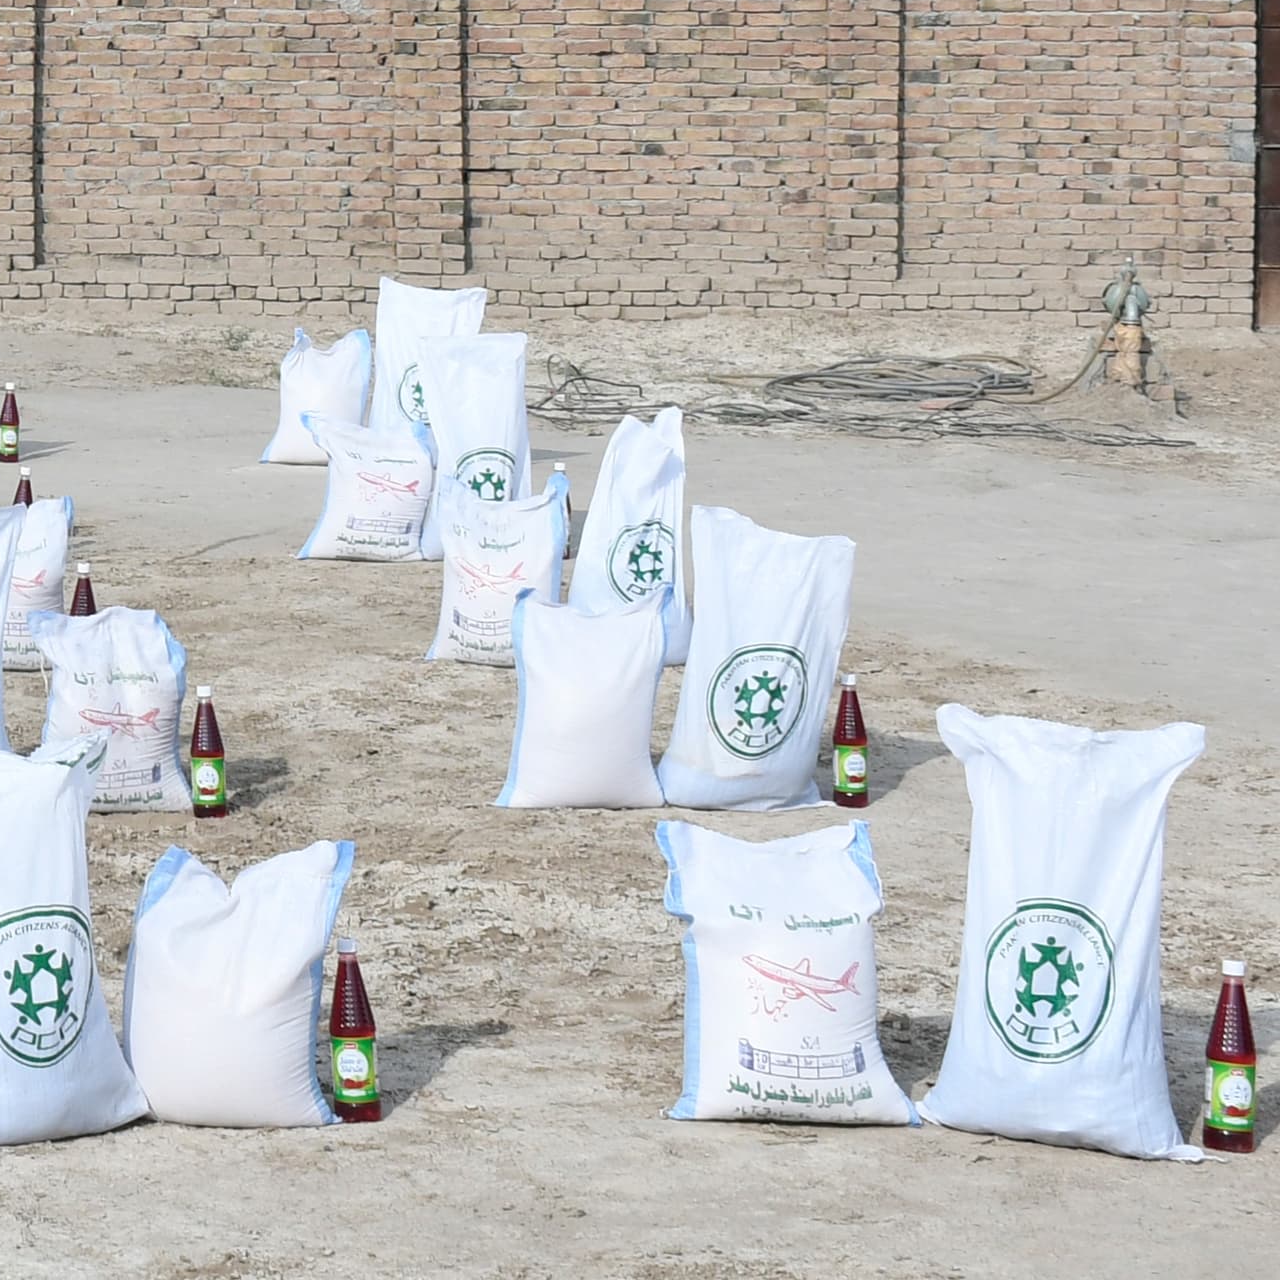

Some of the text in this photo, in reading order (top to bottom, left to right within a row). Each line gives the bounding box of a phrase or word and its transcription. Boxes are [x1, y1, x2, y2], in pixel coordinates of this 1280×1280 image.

[728, 725, 782, 748] PCA
[14, 920, 60, 936] CITIZENS
[752, 995, 788, 1022] جہاز
[11, 1012, 79, 1050] PCA
[1006, 1013, 1080, 1045] PCA
[846, 1080, 873, 1107] فضل
